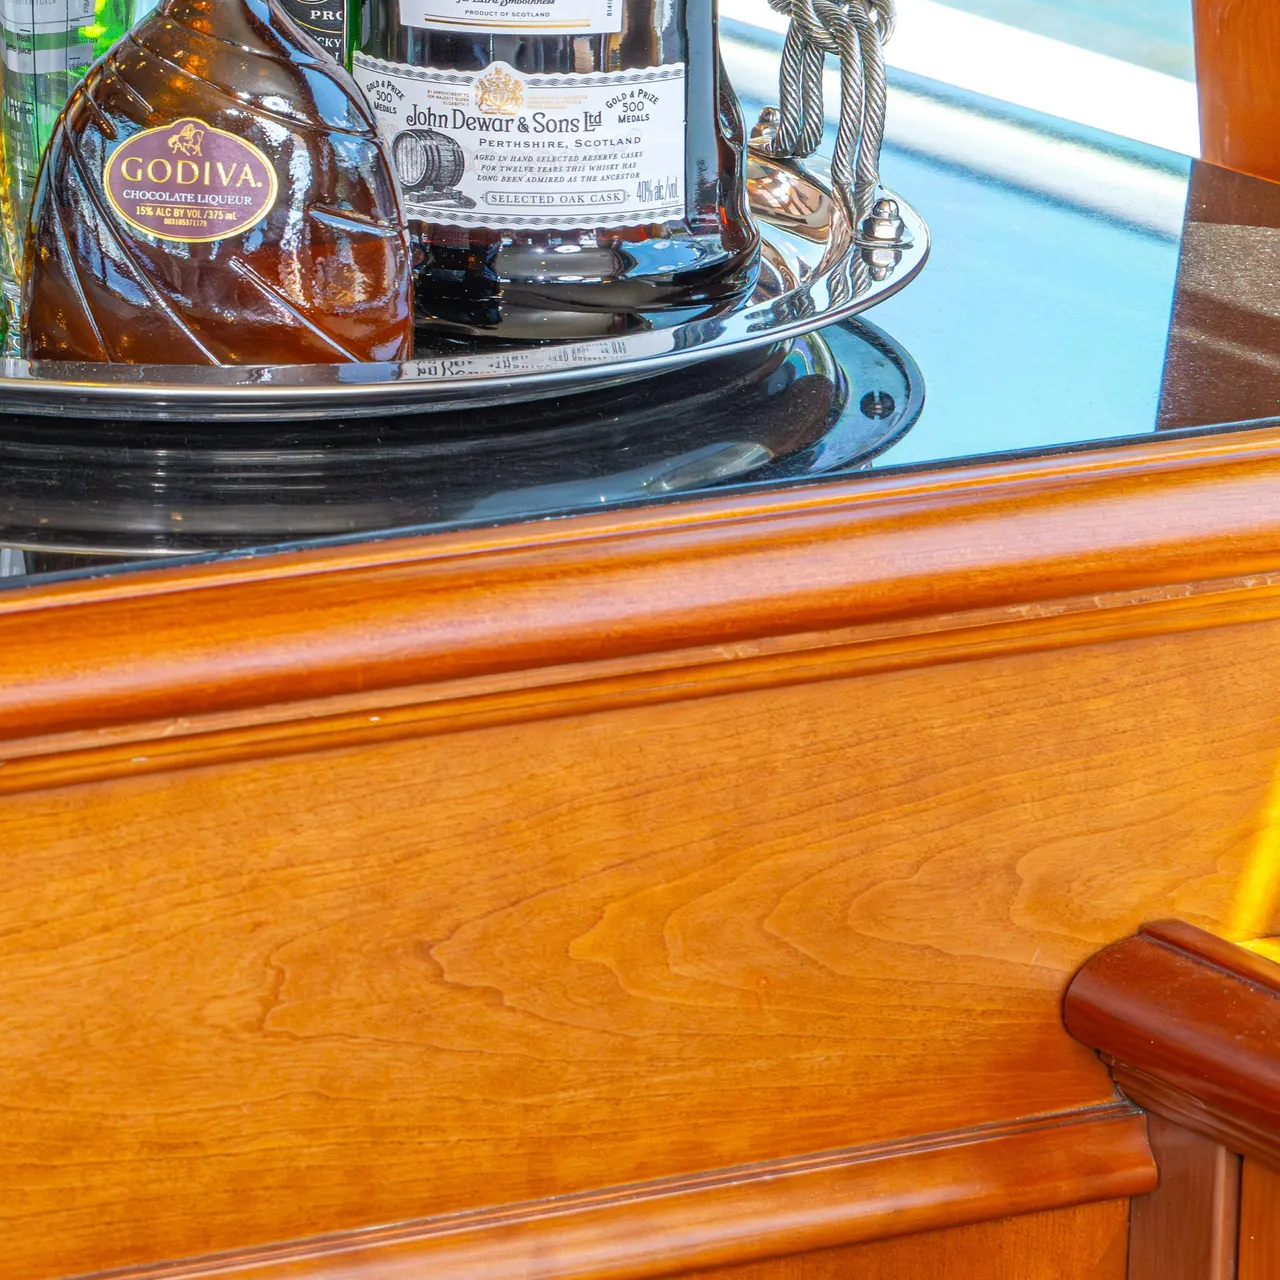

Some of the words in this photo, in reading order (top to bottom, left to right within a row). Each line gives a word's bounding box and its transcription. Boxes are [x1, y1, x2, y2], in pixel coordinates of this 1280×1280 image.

[17, 45, 32, 55] juice
[366, 80, 380, 92] GOLD
[381, 80, 385, 88] &
[386, 80, 405, 101] PRIZE
[376, 90, 393, 103] 500
[605, 91, 627, 109] GOLD
[630, 90, 635, 98] &
[637, 89, 660, 106] PRIZE
[373, 102, 397, 115] MEDALS
[622, 101, 645, 113] 500
[406, 104, 448, 128] John
[451, 108, 515, 133] Dewar
[517, 117, 529, 133] &
[532, 111, 580, 133] Sons
[583, 111, 602, 132] Ltd
[618, 113, 650, 124] MEDALS
[479, 138, 569, 149] PERTHSHIRE,
[574, 136, 641, 148] SCOTLAND
[582, 153, 618, 161] RESERVE
[620, 151, 643, 159] CASKS
[499, 165, 534, 173] TWELVE
[566, 165, 586, 173] THIS
[588, 163, 620, 171] WHISKY
[622, 161, 638, 170] HAS
[476, 174, 498, 182] LONG
[500, 175, 523, 183] BEEN
[567, 175, 577, 183] AS
[599, 172, 640, 182] ANCESTOR
[123, 190, 195, 203] CHOCOLATE
[197, 193, 252, 206] LIQUEUR
[636, 180, 653, 203] 40%
[491, 195, 555, 204] SELECTED
[559, 195, 585, 204] OAK
[590, 193, 621, 202] CASK
[136, 206, 154, 216] 15%
[155, 206, 172, 217] ALC
[173, 207, 185, 218] BY
[186, 208, 203, 219] VOL
